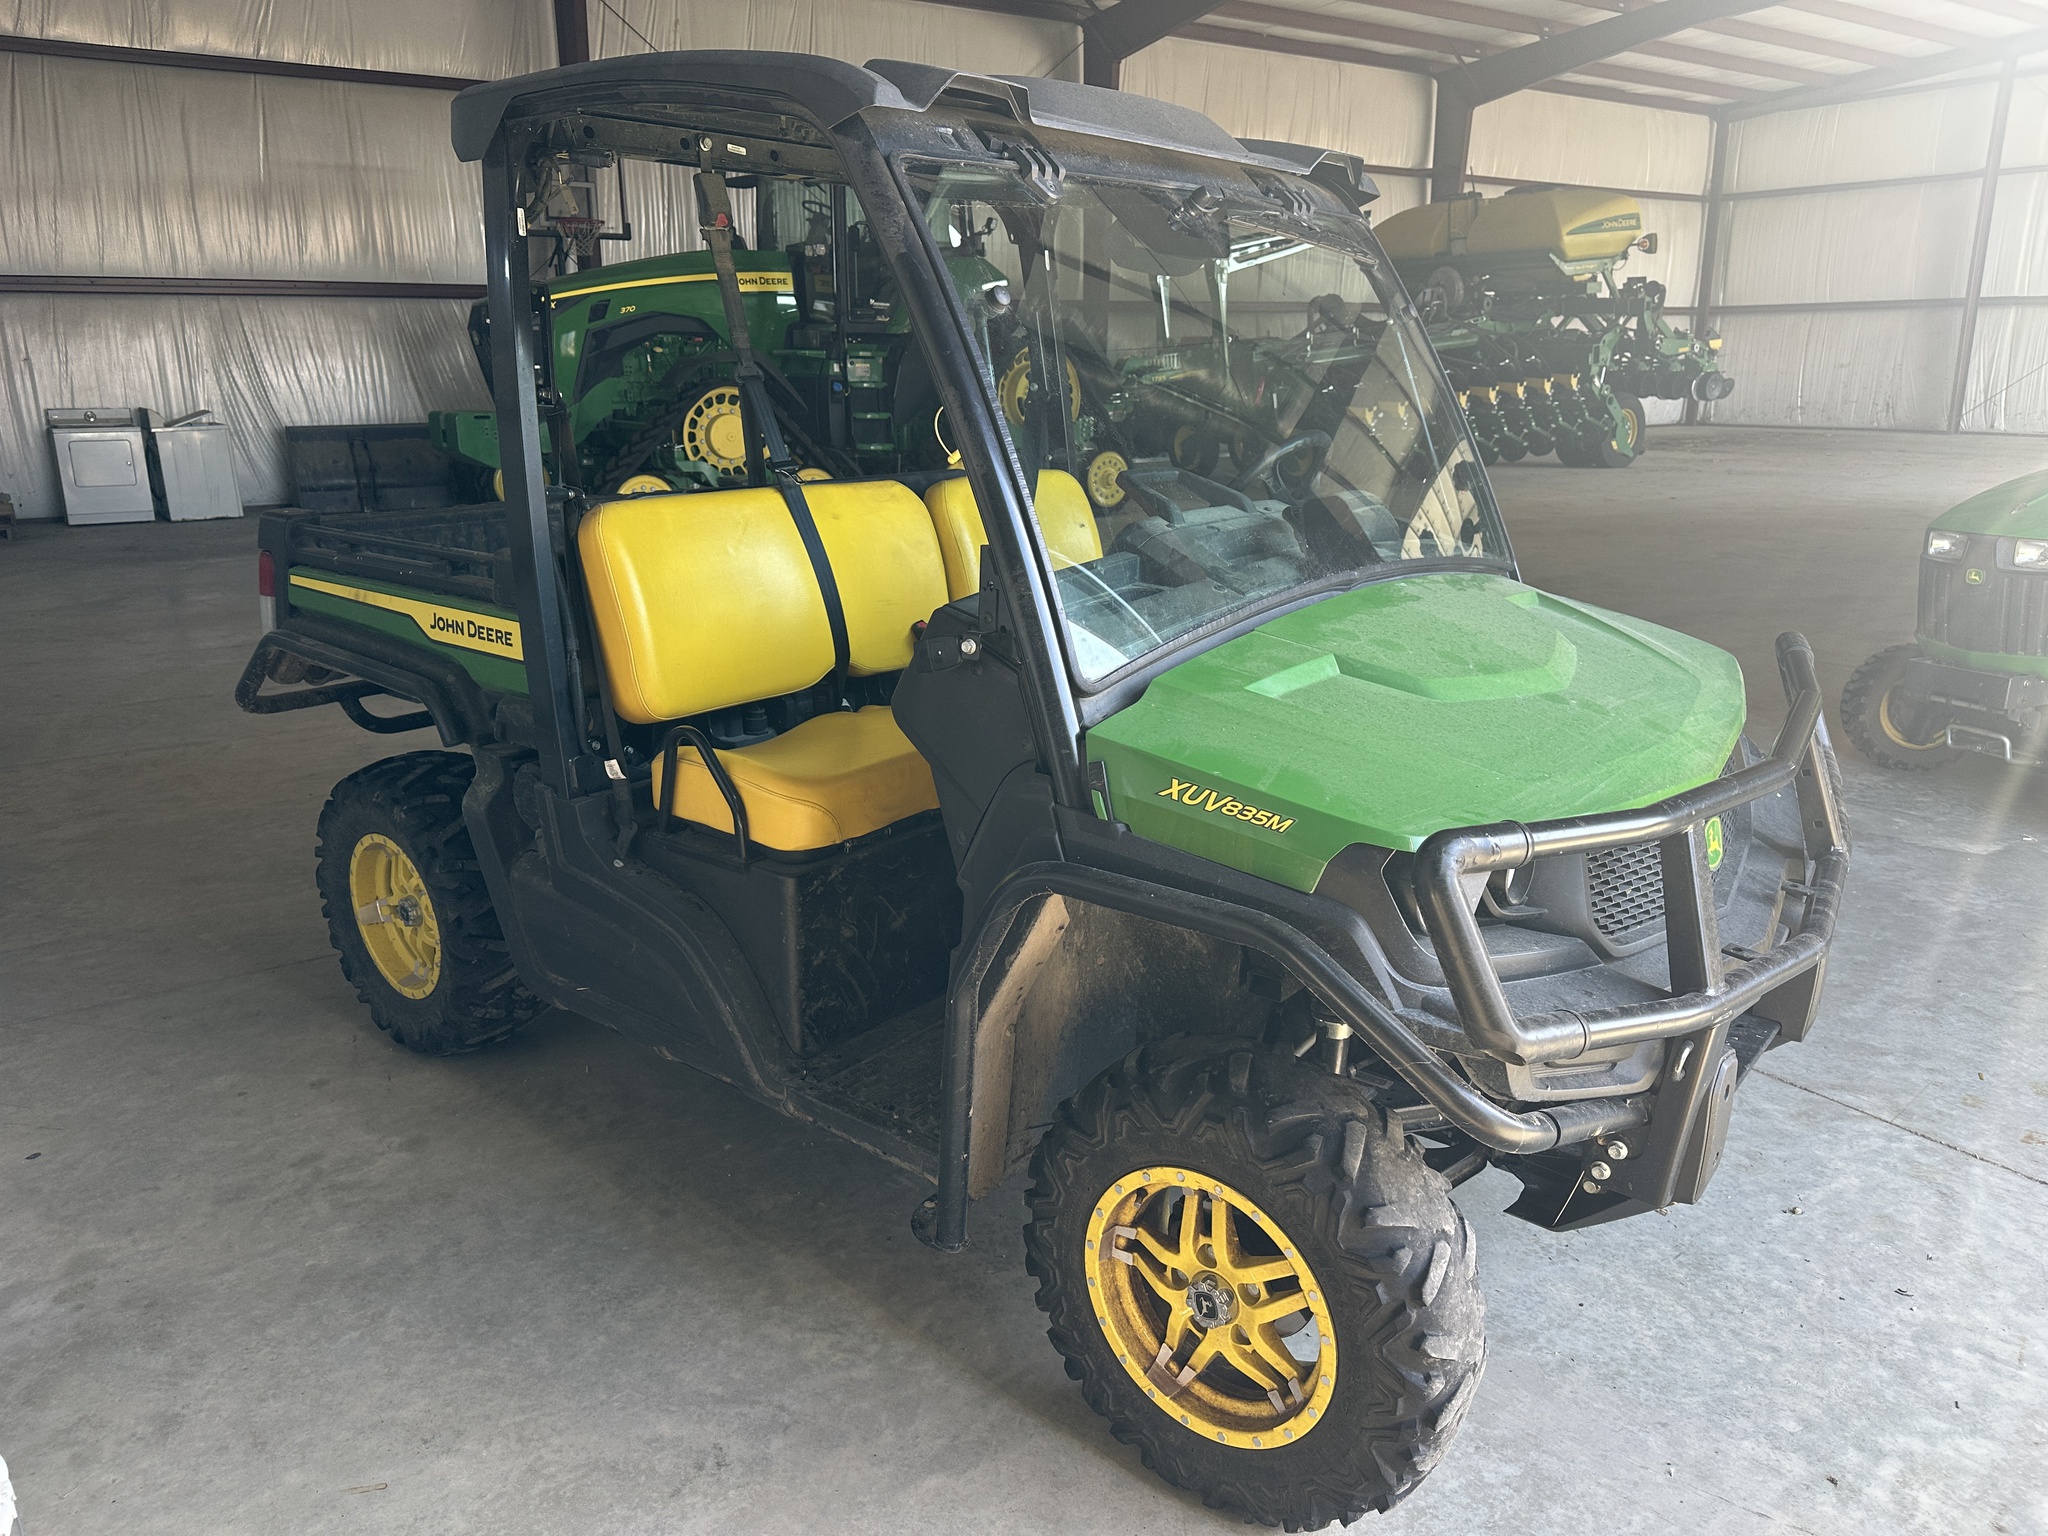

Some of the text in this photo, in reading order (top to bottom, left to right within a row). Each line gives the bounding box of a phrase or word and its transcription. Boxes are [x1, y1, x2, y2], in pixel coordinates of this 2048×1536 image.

[1602, 219, 1636, 229] JOHN DEERE
[738, 276, 788, 286] OHN DEERE
[620, 305, 636, 314] 370
[430, 612, 513, 647] JOHN DEERE
[1156, 777, 1296, 834] XUV835M
